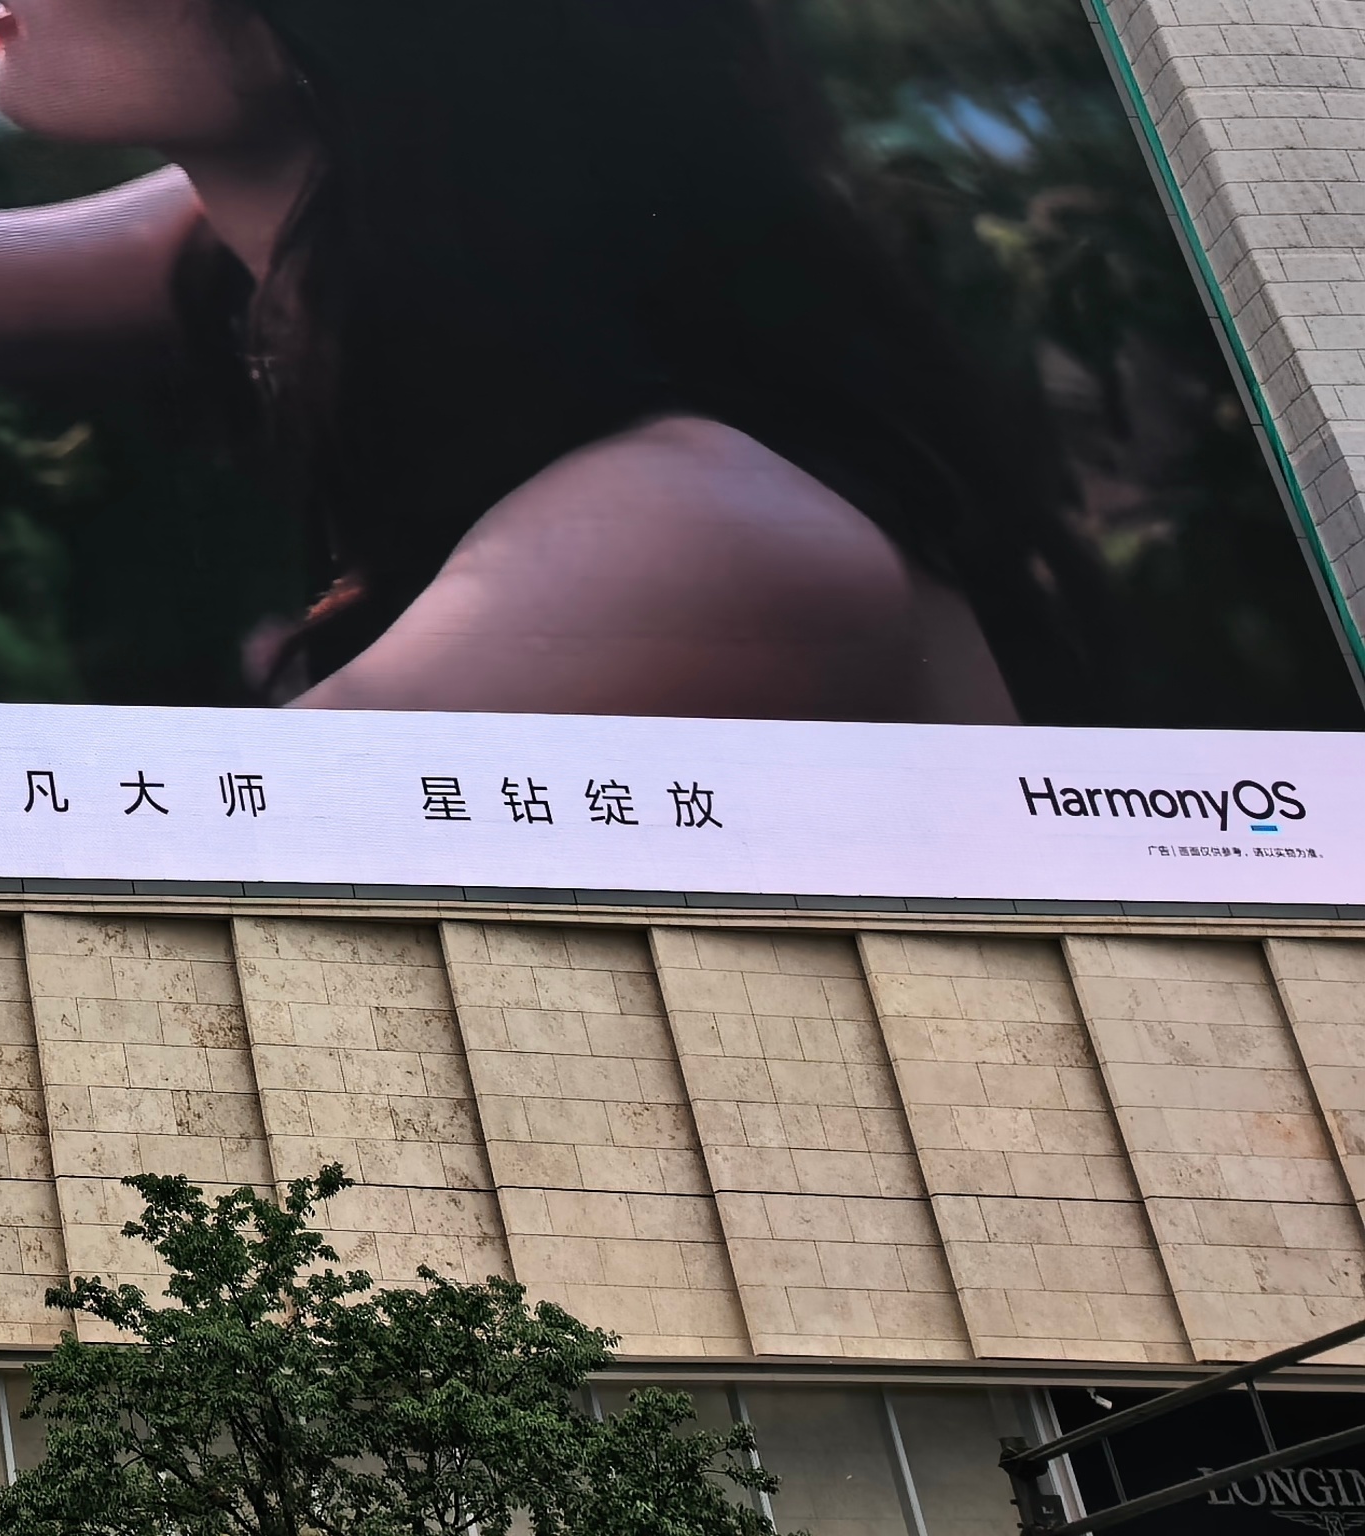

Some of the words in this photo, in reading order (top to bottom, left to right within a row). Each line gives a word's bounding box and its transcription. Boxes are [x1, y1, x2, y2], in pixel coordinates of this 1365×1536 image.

[420, 776, 723, 830] 星钻绽放
[1018, 776, 1307, 832] HarmonyOS
